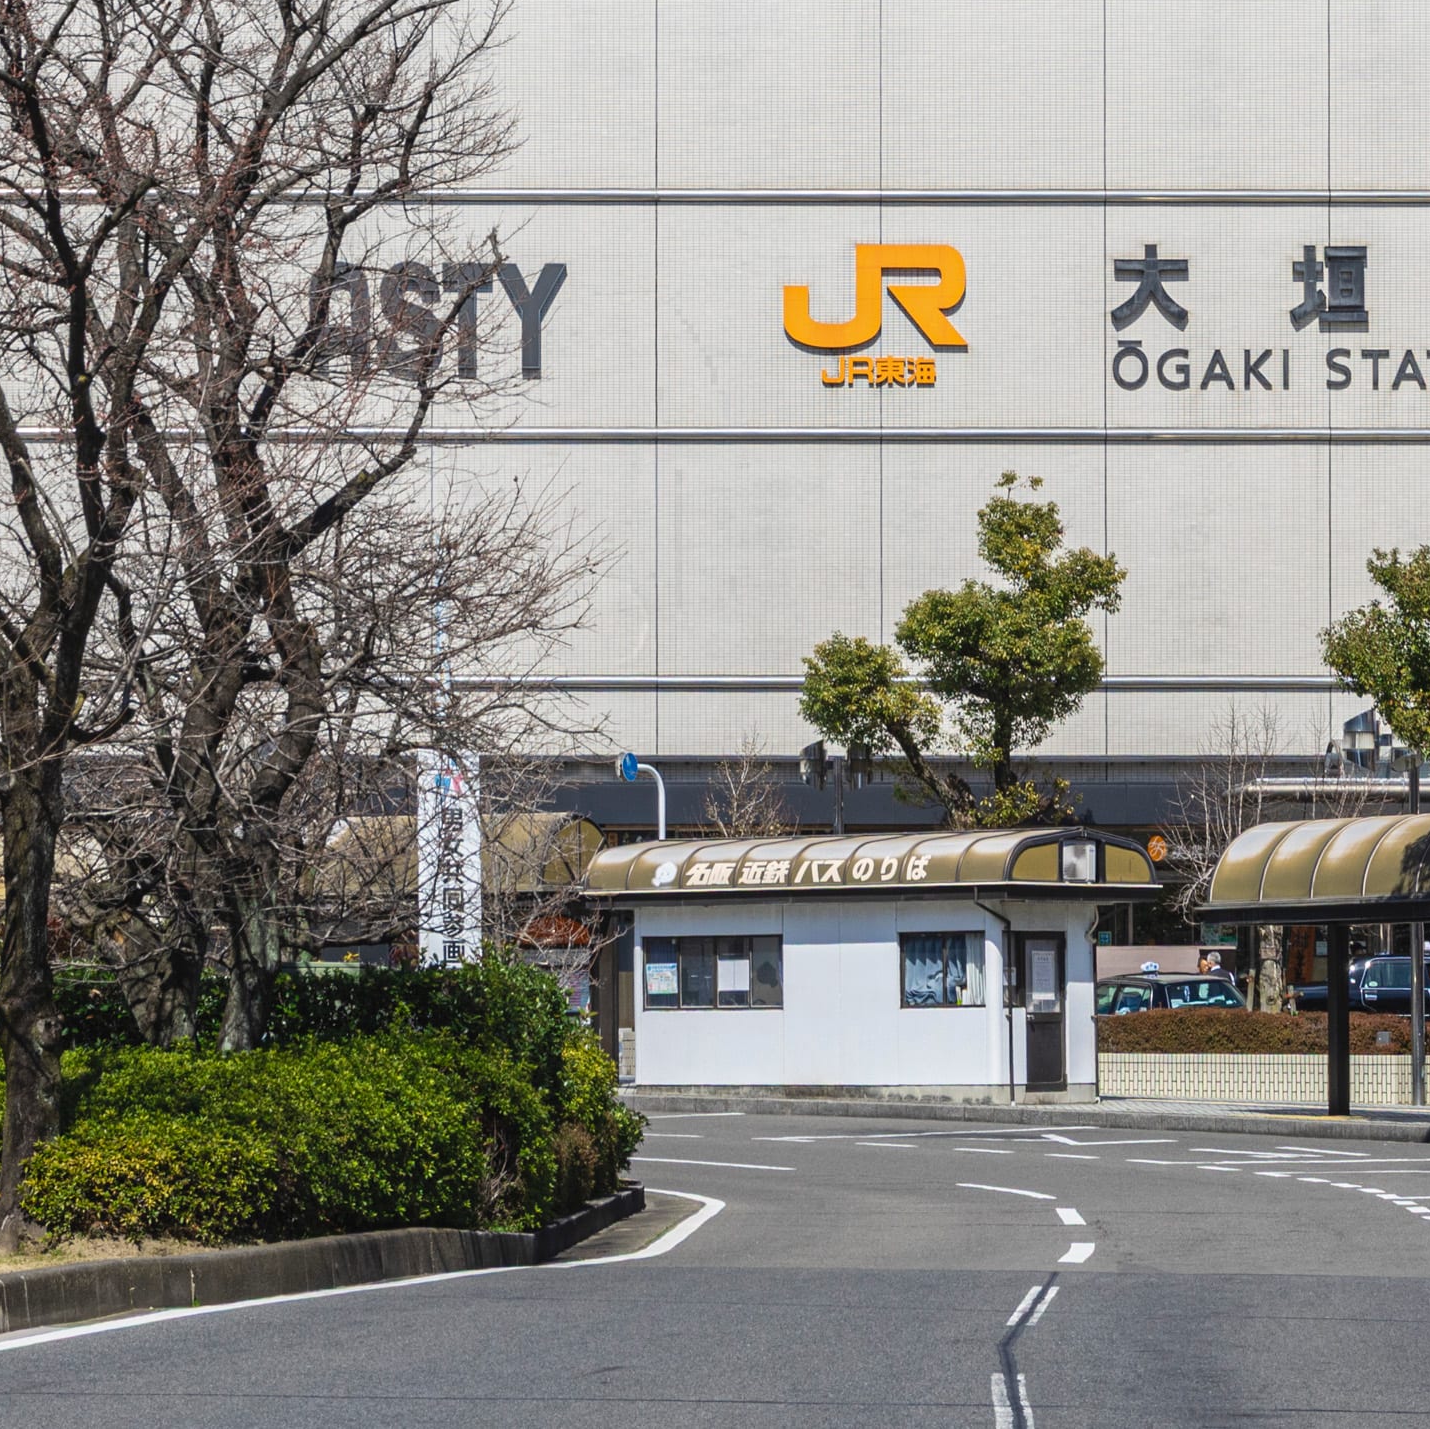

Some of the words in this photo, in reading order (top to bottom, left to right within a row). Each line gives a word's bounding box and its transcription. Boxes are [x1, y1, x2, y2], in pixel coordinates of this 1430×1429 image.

[783, 243, 968, 350] JR
[821, 355, 937, 386] JR東海
[1112, 340, 1290, 392] ŌGAKI
